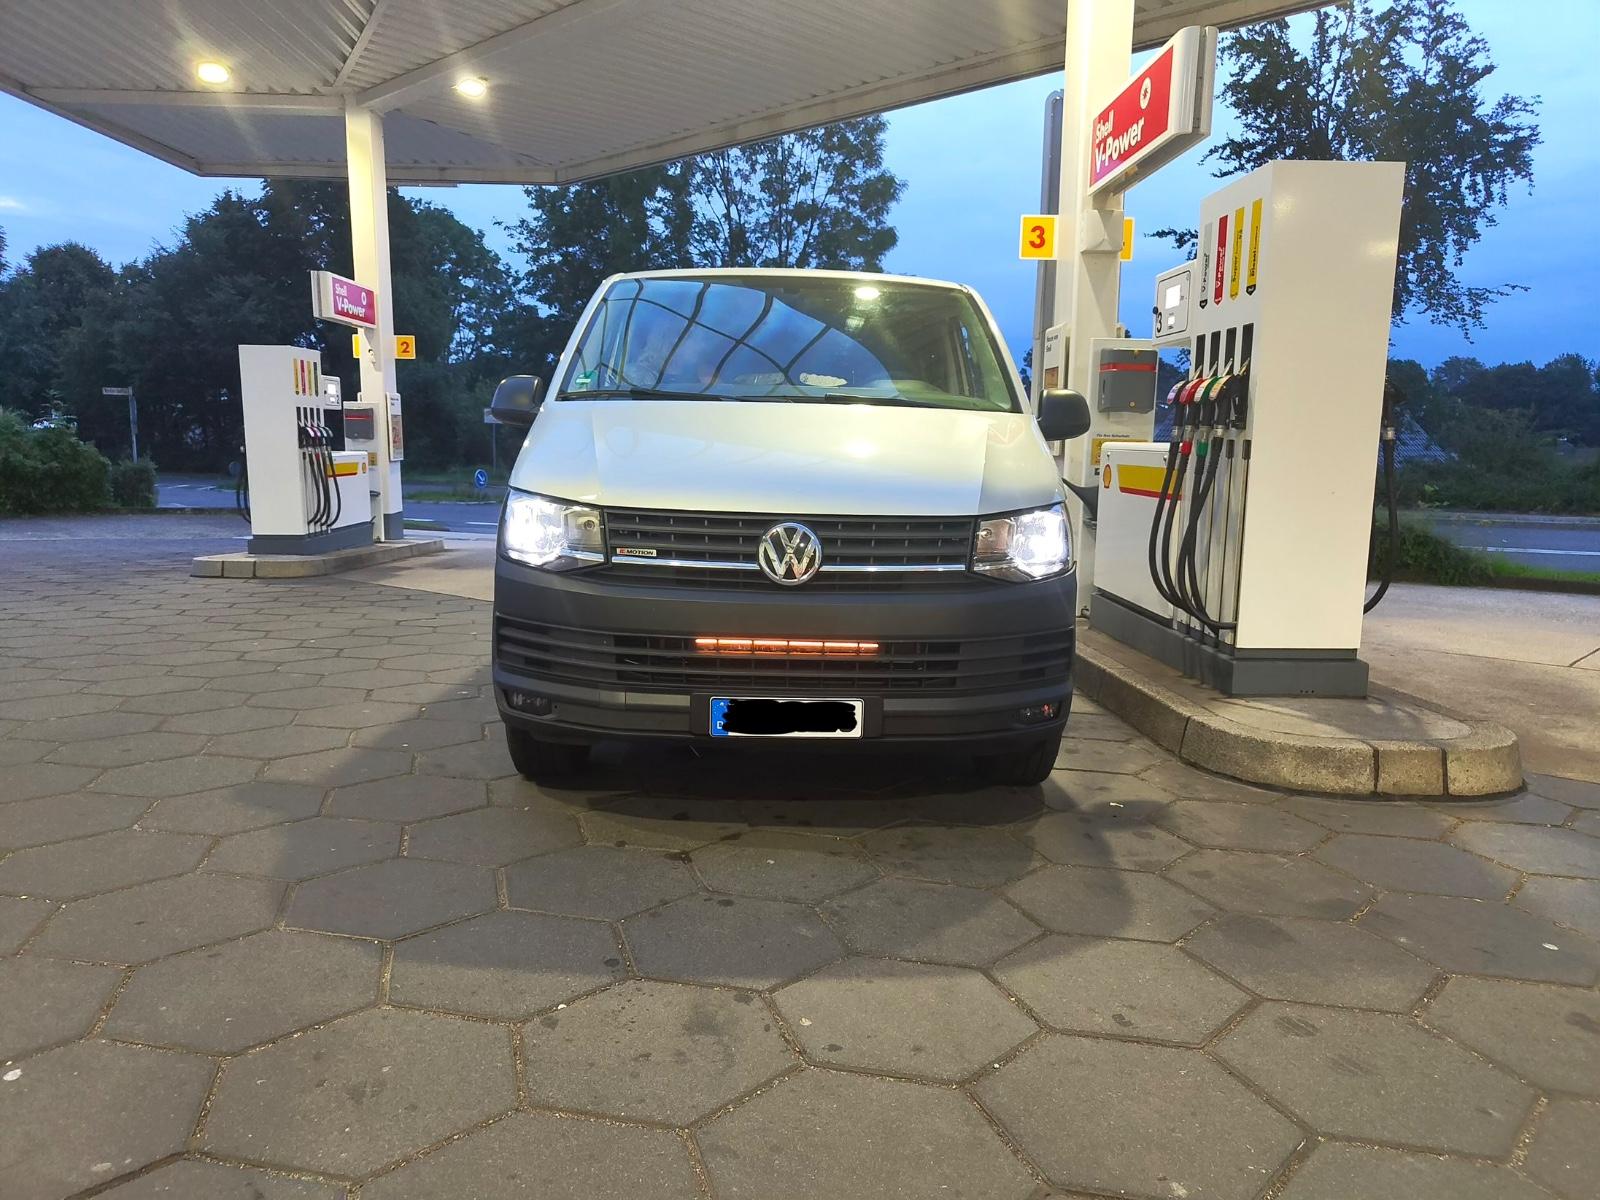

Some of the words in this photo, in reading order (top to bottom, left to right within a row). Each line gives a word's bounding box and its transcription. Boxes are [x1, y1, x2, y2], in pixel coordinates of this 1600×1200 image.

[1095, 109, 1114, 144] Shell
[1095, 117, 1145, 173] V-Power
[1028, 225, 1046, 249] 3
[335, 283, 347, 297] Shell
[336, 295, 366, 318] V-Power
[1156, 312, 1162, 333] 3
[400, 341, 410, 354] 2
